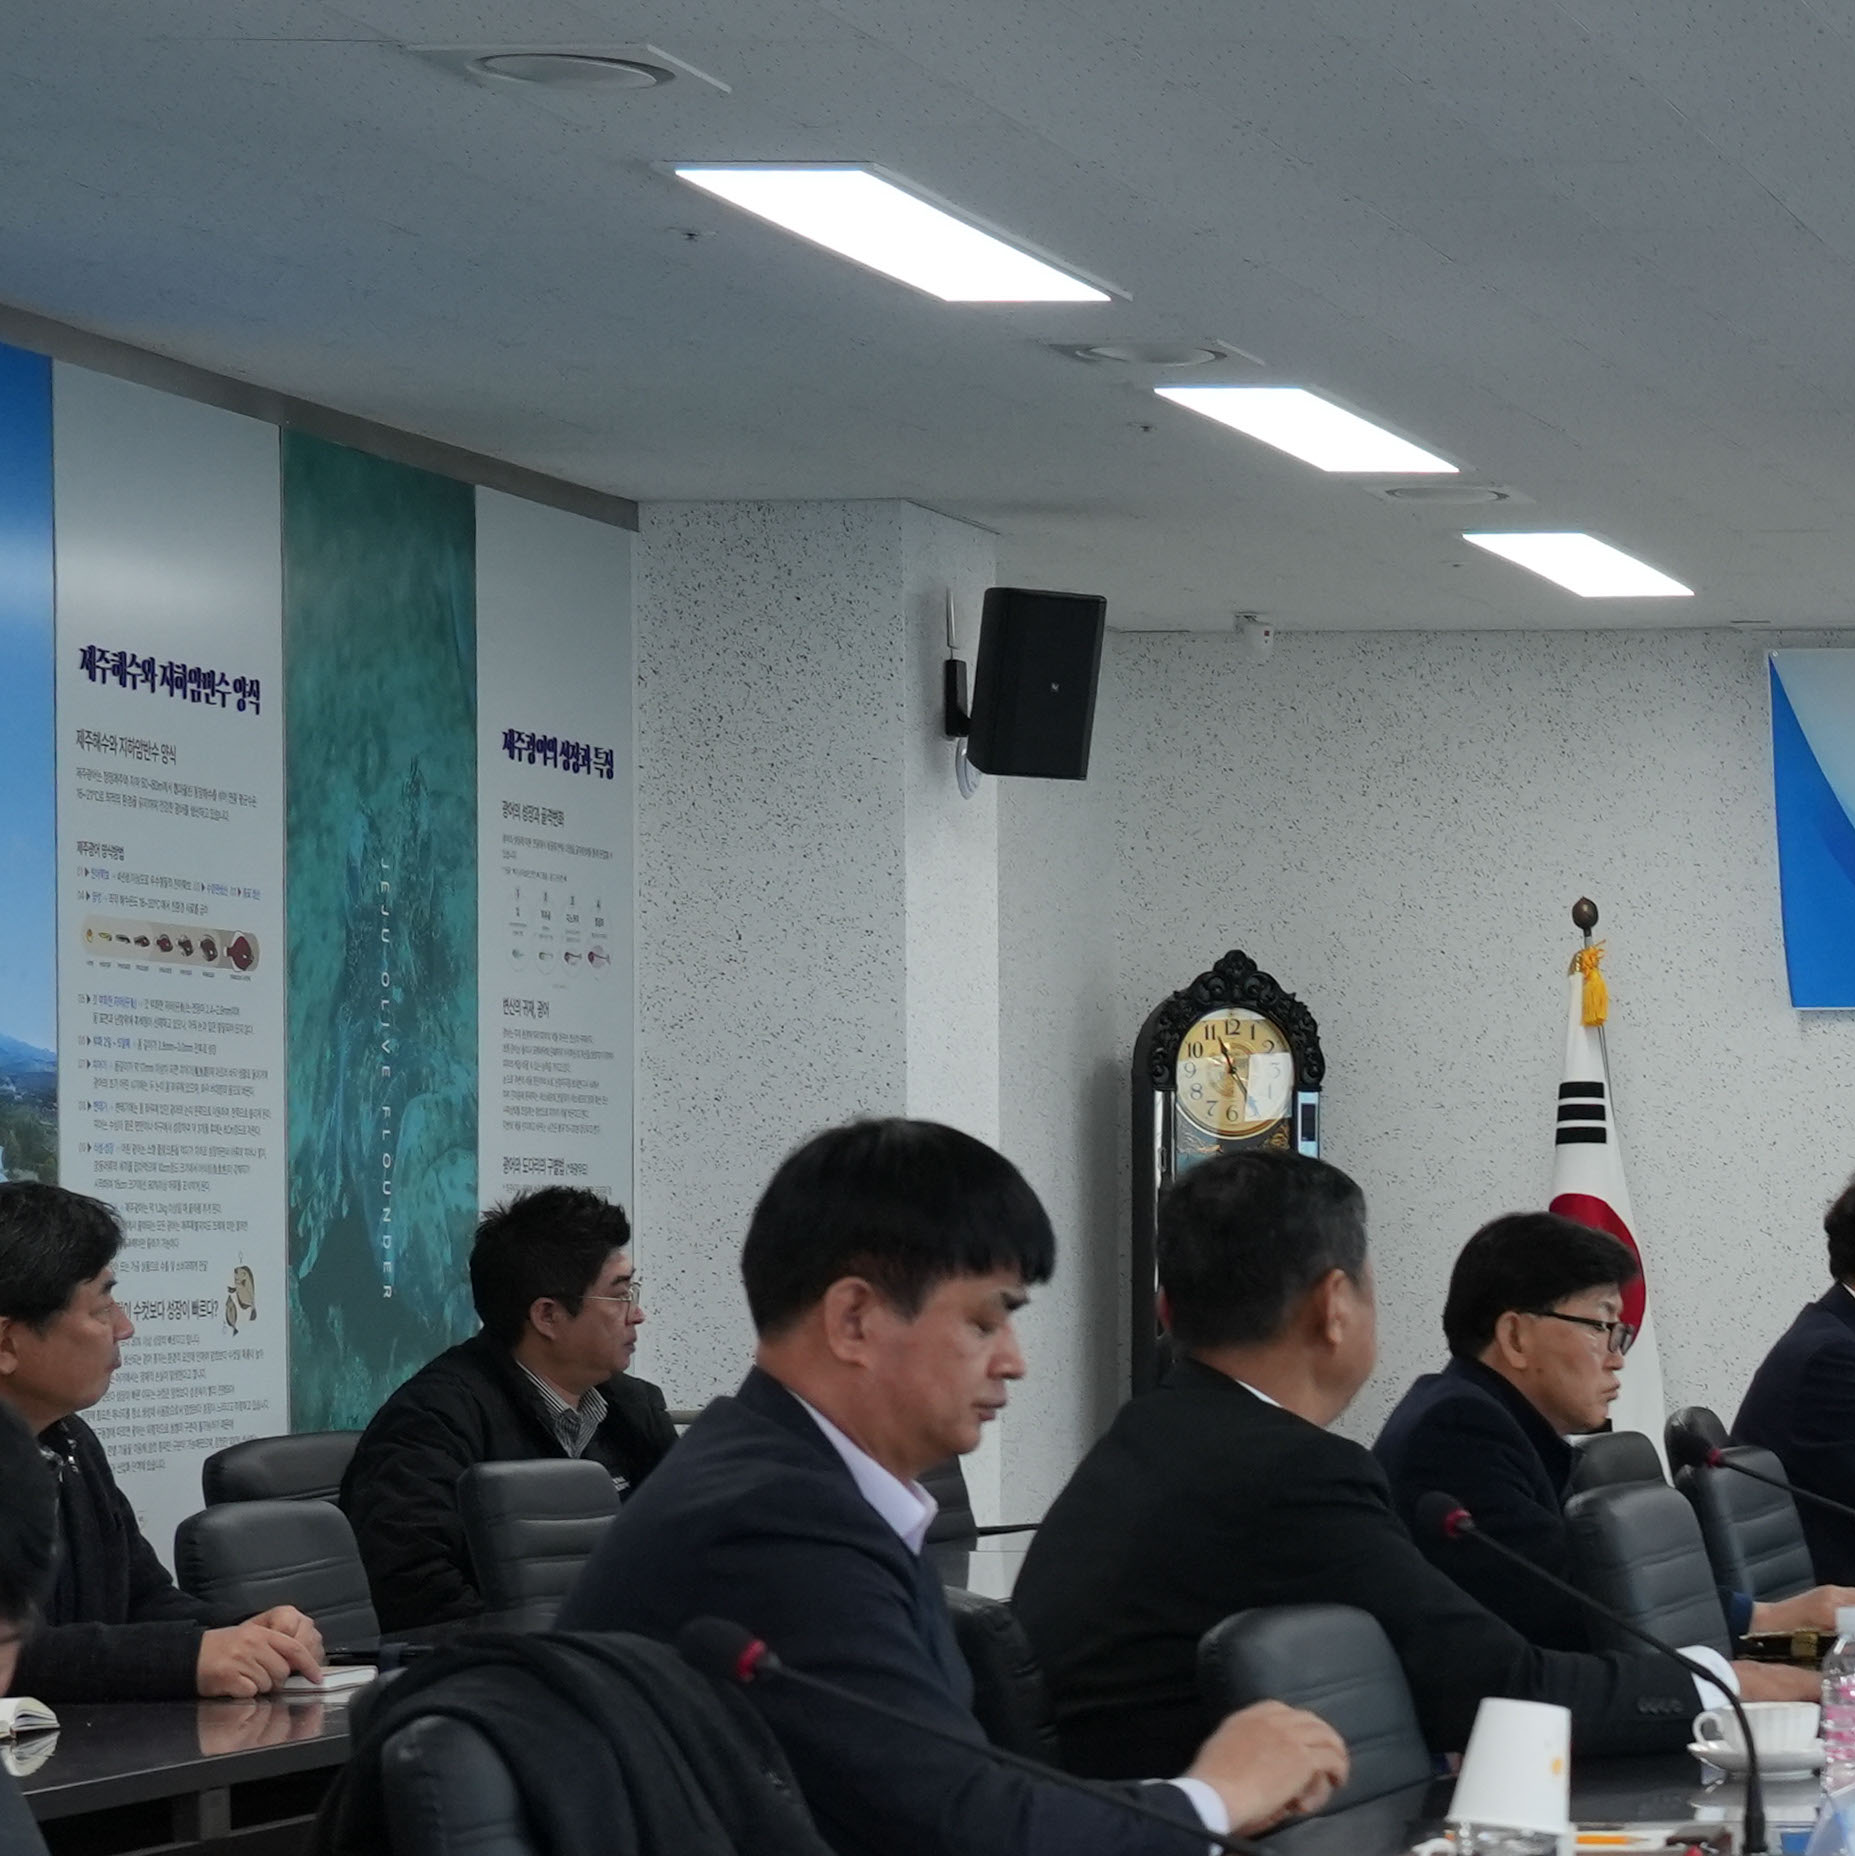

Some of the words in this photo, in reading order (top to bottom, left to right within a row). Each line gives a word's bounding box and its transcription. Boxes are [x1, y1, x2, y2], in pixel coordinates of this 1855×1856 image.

[79, 644, 158, 695] 제주해수와
[159, 661, 232, 708] 지하암반수
[233, 677, 261, 715] 양식
[76, 728, 118, 752] 제주해수와
[119, 736, 160, 762] 지하암반수
[160, 743, 177, 766] 양식
[502, 728, 557, 768] 제주광어의
[559, 741, 592, 775] 성장과
[593, 747, 614, 780] 특징
[502, 800, 521, 821] 광어의
[522, 804, 540, 825] 성장과
[379, 857, 391, 944] JEJU
[503, 998, 521, 1017] 변신의
[380, 971, 391, 1079] OLIVE
[1204, 1024, 1216, 1041] 11
[1225, 1019, 1240, 1036] 12
[1250, 1024, 1255, 1040] 1
[1187, 1041, 1203, 1058] 10
[1262, 1040, 1275, 1053] 2
[1184, 1062, 1196, 1078] 9
[1270, 1062, 1281, 1079] 3
[1190, 1083, 1203, 1100] 8
[1206, 1100, 1218, 1117] 7
[1226, 1104, 1239, 1122] 6
[381, 1106, 393, 1298] FLOUNDER
[133, 1299, 165, 1321] 수컷보다
[167, 1299, 190, 1321] 성장이
[192, 1298, 219, 1321] 빠르다?
